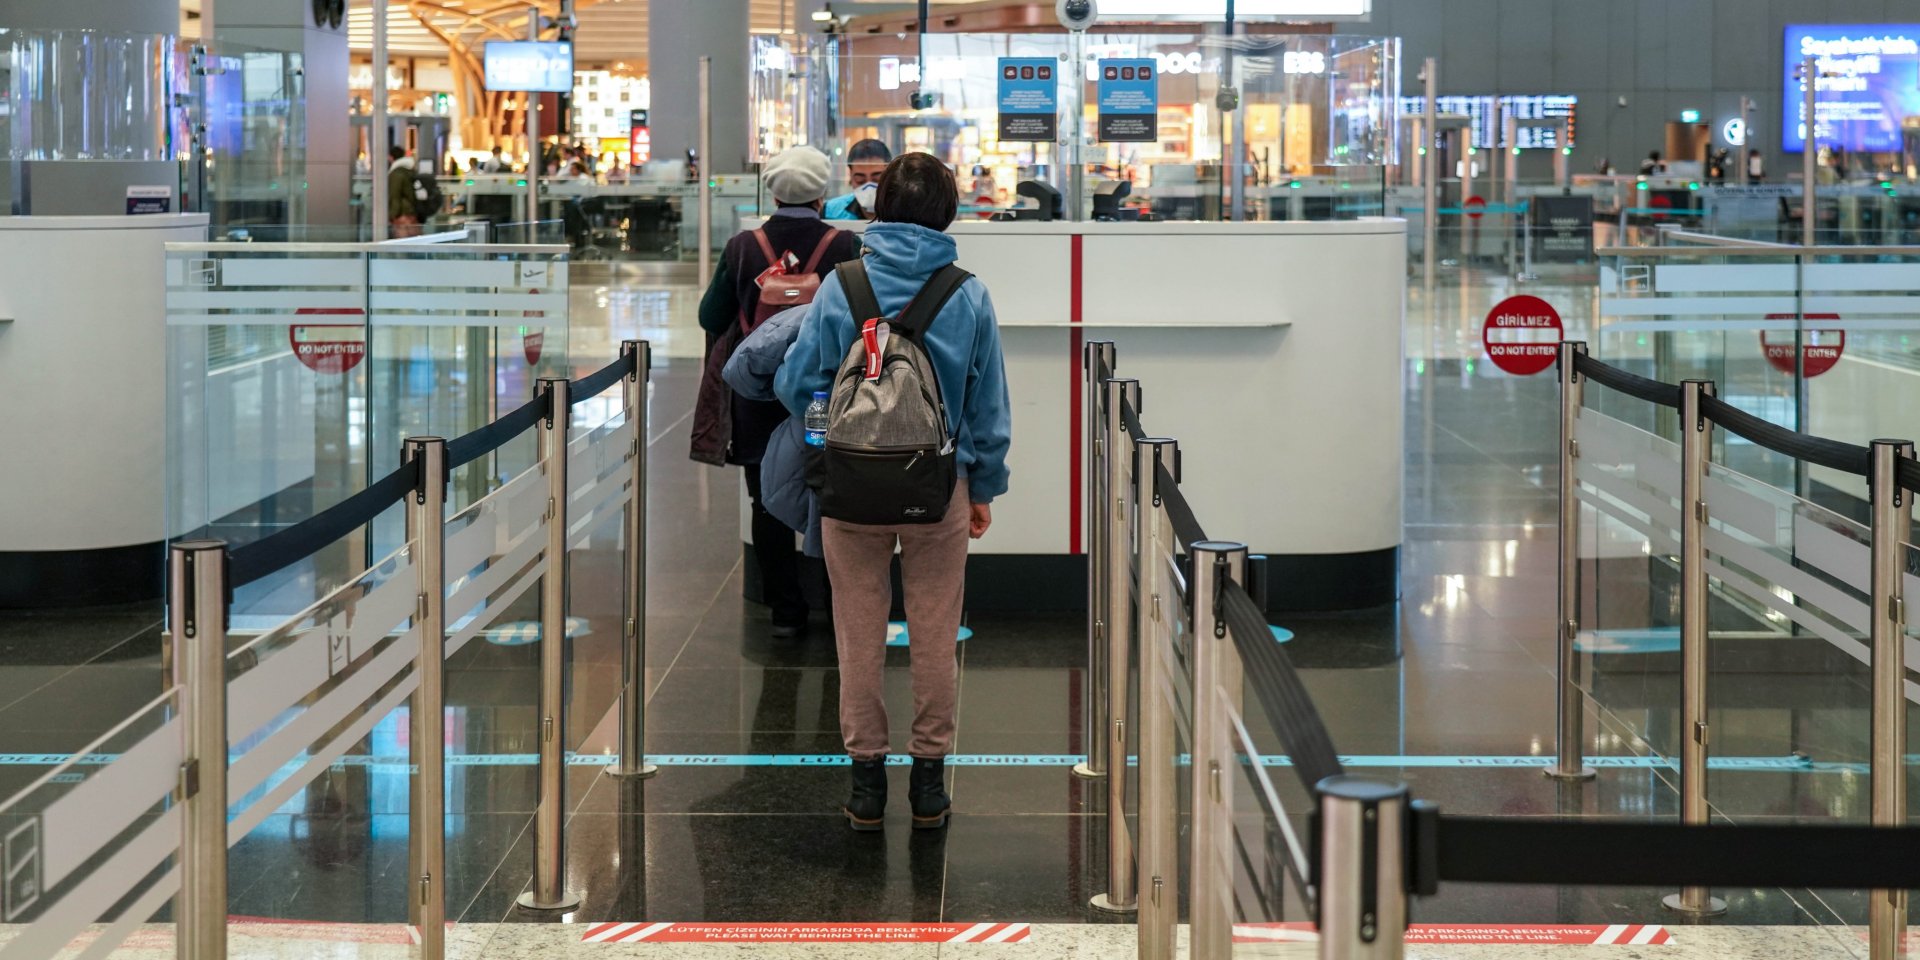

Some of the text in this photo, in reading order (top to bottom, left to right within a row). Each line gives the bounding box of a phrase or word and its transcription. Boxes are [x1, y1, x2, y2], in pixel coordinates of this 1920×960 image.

[1496, 313, 1551, 327] GİRİLMEZ
[299, 345, 363, 354] DO NOT ENTER
[1491, 346, 1556, 356] DO NOT ENTER
[1807, 348, 1837, 358] ENTER
